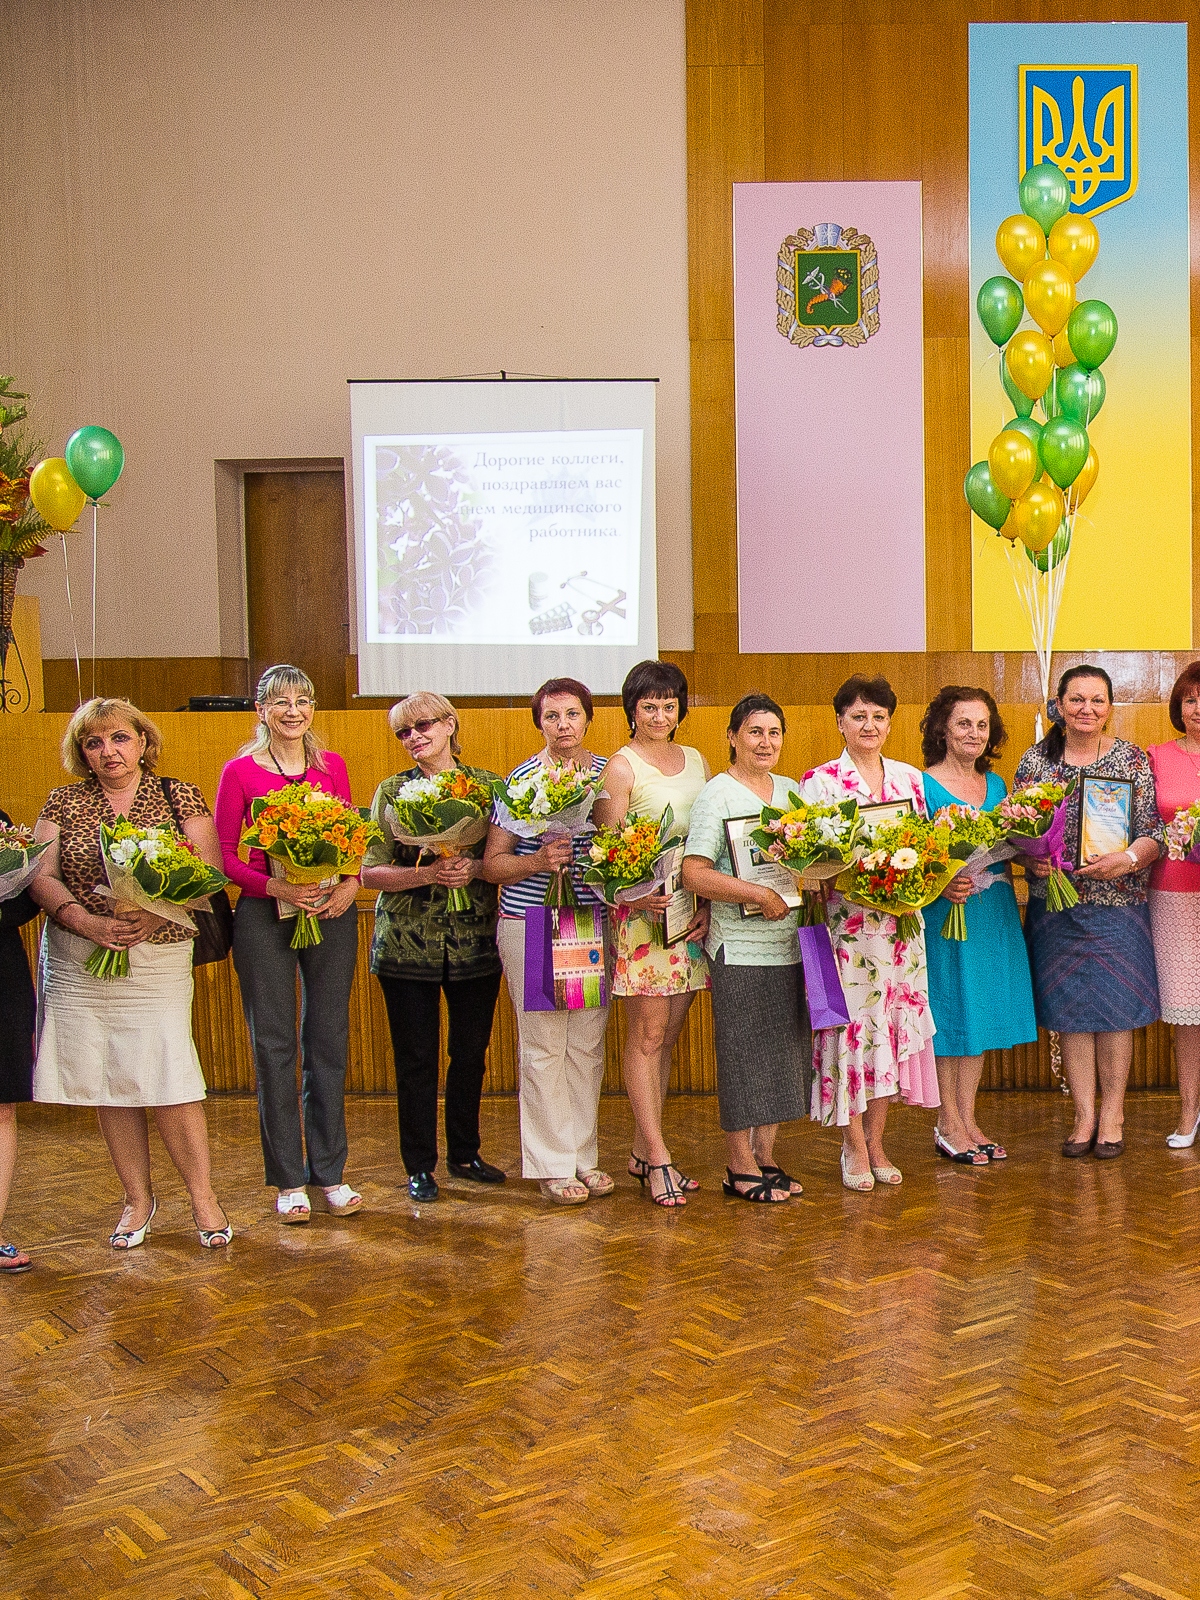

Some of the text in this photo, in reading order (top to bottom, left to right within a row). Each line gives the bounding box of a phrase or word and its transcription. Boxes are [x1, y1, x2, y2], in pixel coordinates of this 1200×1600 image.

[473, 452, 624, 470] Дорогие коллеги,
[482, 478, 623, 494] поздравляем вас
[502, 502, 622, 516] медицинского
[529, 523, 621, 542] работника.
